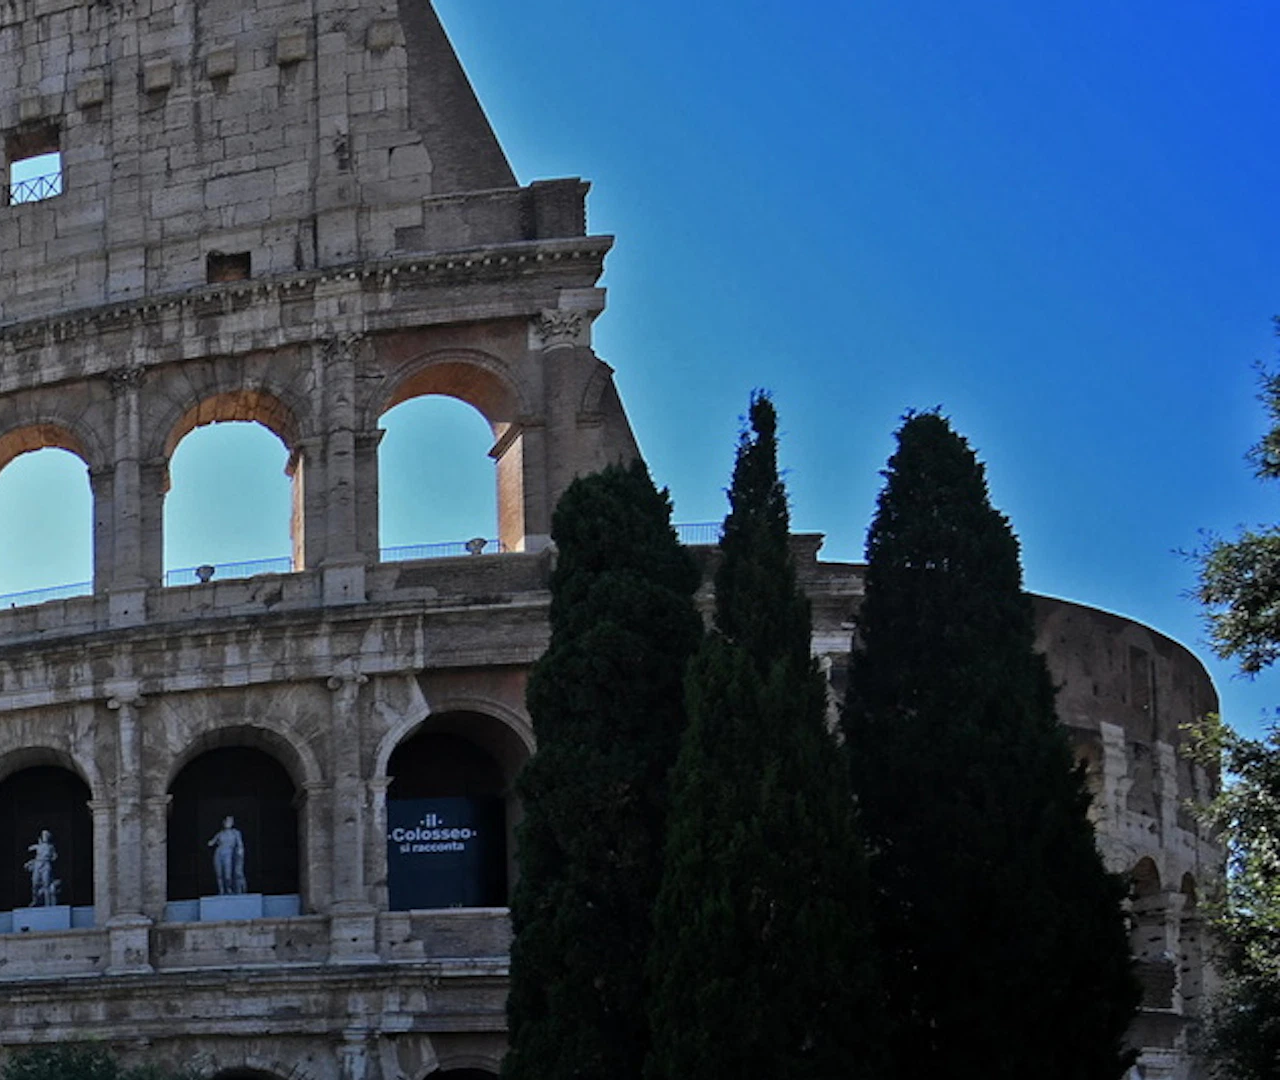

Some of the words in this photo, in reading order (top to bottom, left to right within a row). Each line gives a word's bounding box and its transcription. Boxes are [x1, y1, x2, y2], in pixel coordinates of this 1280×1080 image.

[392, 828, 471, 842] Colosseo
[400, 844, 411, 853] si
[412, 841, 464, 852] racconta
